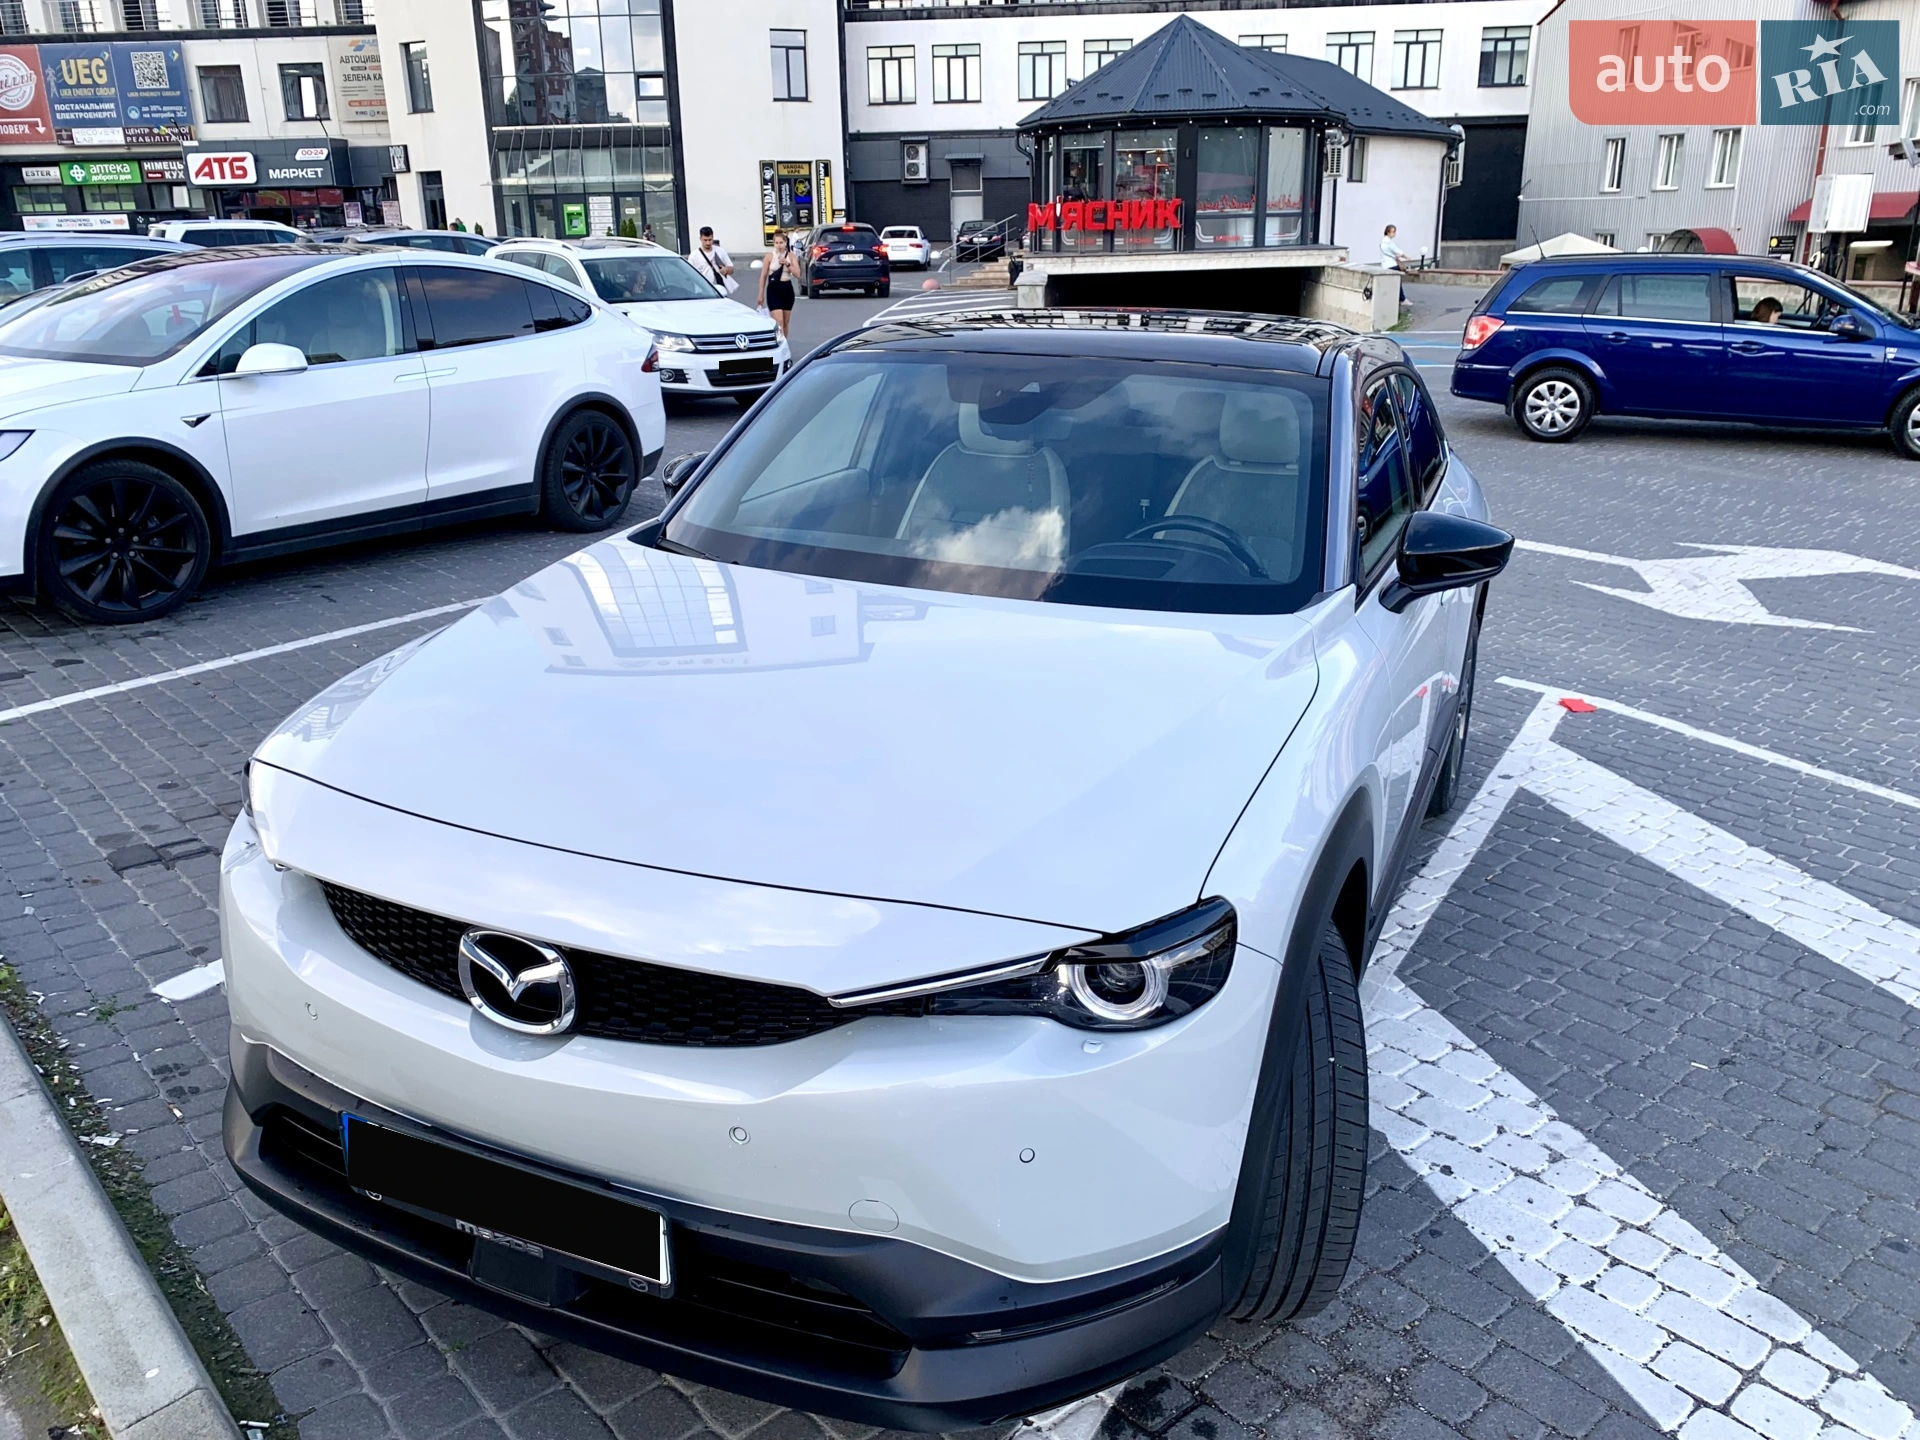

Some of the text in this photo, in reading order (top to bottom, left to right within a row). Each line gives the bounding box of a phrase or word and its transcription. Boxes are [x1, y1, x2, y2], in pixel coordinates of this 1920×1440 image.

[60, 58, 109, 86] UEG
[343, 73, 384, 82] ЗЕЛЕНА КА
[73, 88, 95, 96] ENERGY
[96, 87, 116, 96] GROUP
[54, 103, 115, 111] ПОСТАЧАЛЬНИК
[56, 110, 117, 119] ЕЛЕКТРОЕНЕРГІЇ
[90, 163, 131, 174] аптека
[143, 161, 184, 171] НІМЕЦЬ
[195, 156, 248, 180] АТБ
[165, 171, 185, 179] КУХ
[268, 168, 324, 179] МАРКЕТ
[763, 183, 774, 223] VANDAL
[1028, 196, 1182, 232] М'ЯСНИК
[456, 1218, 544, 1259] mazda
